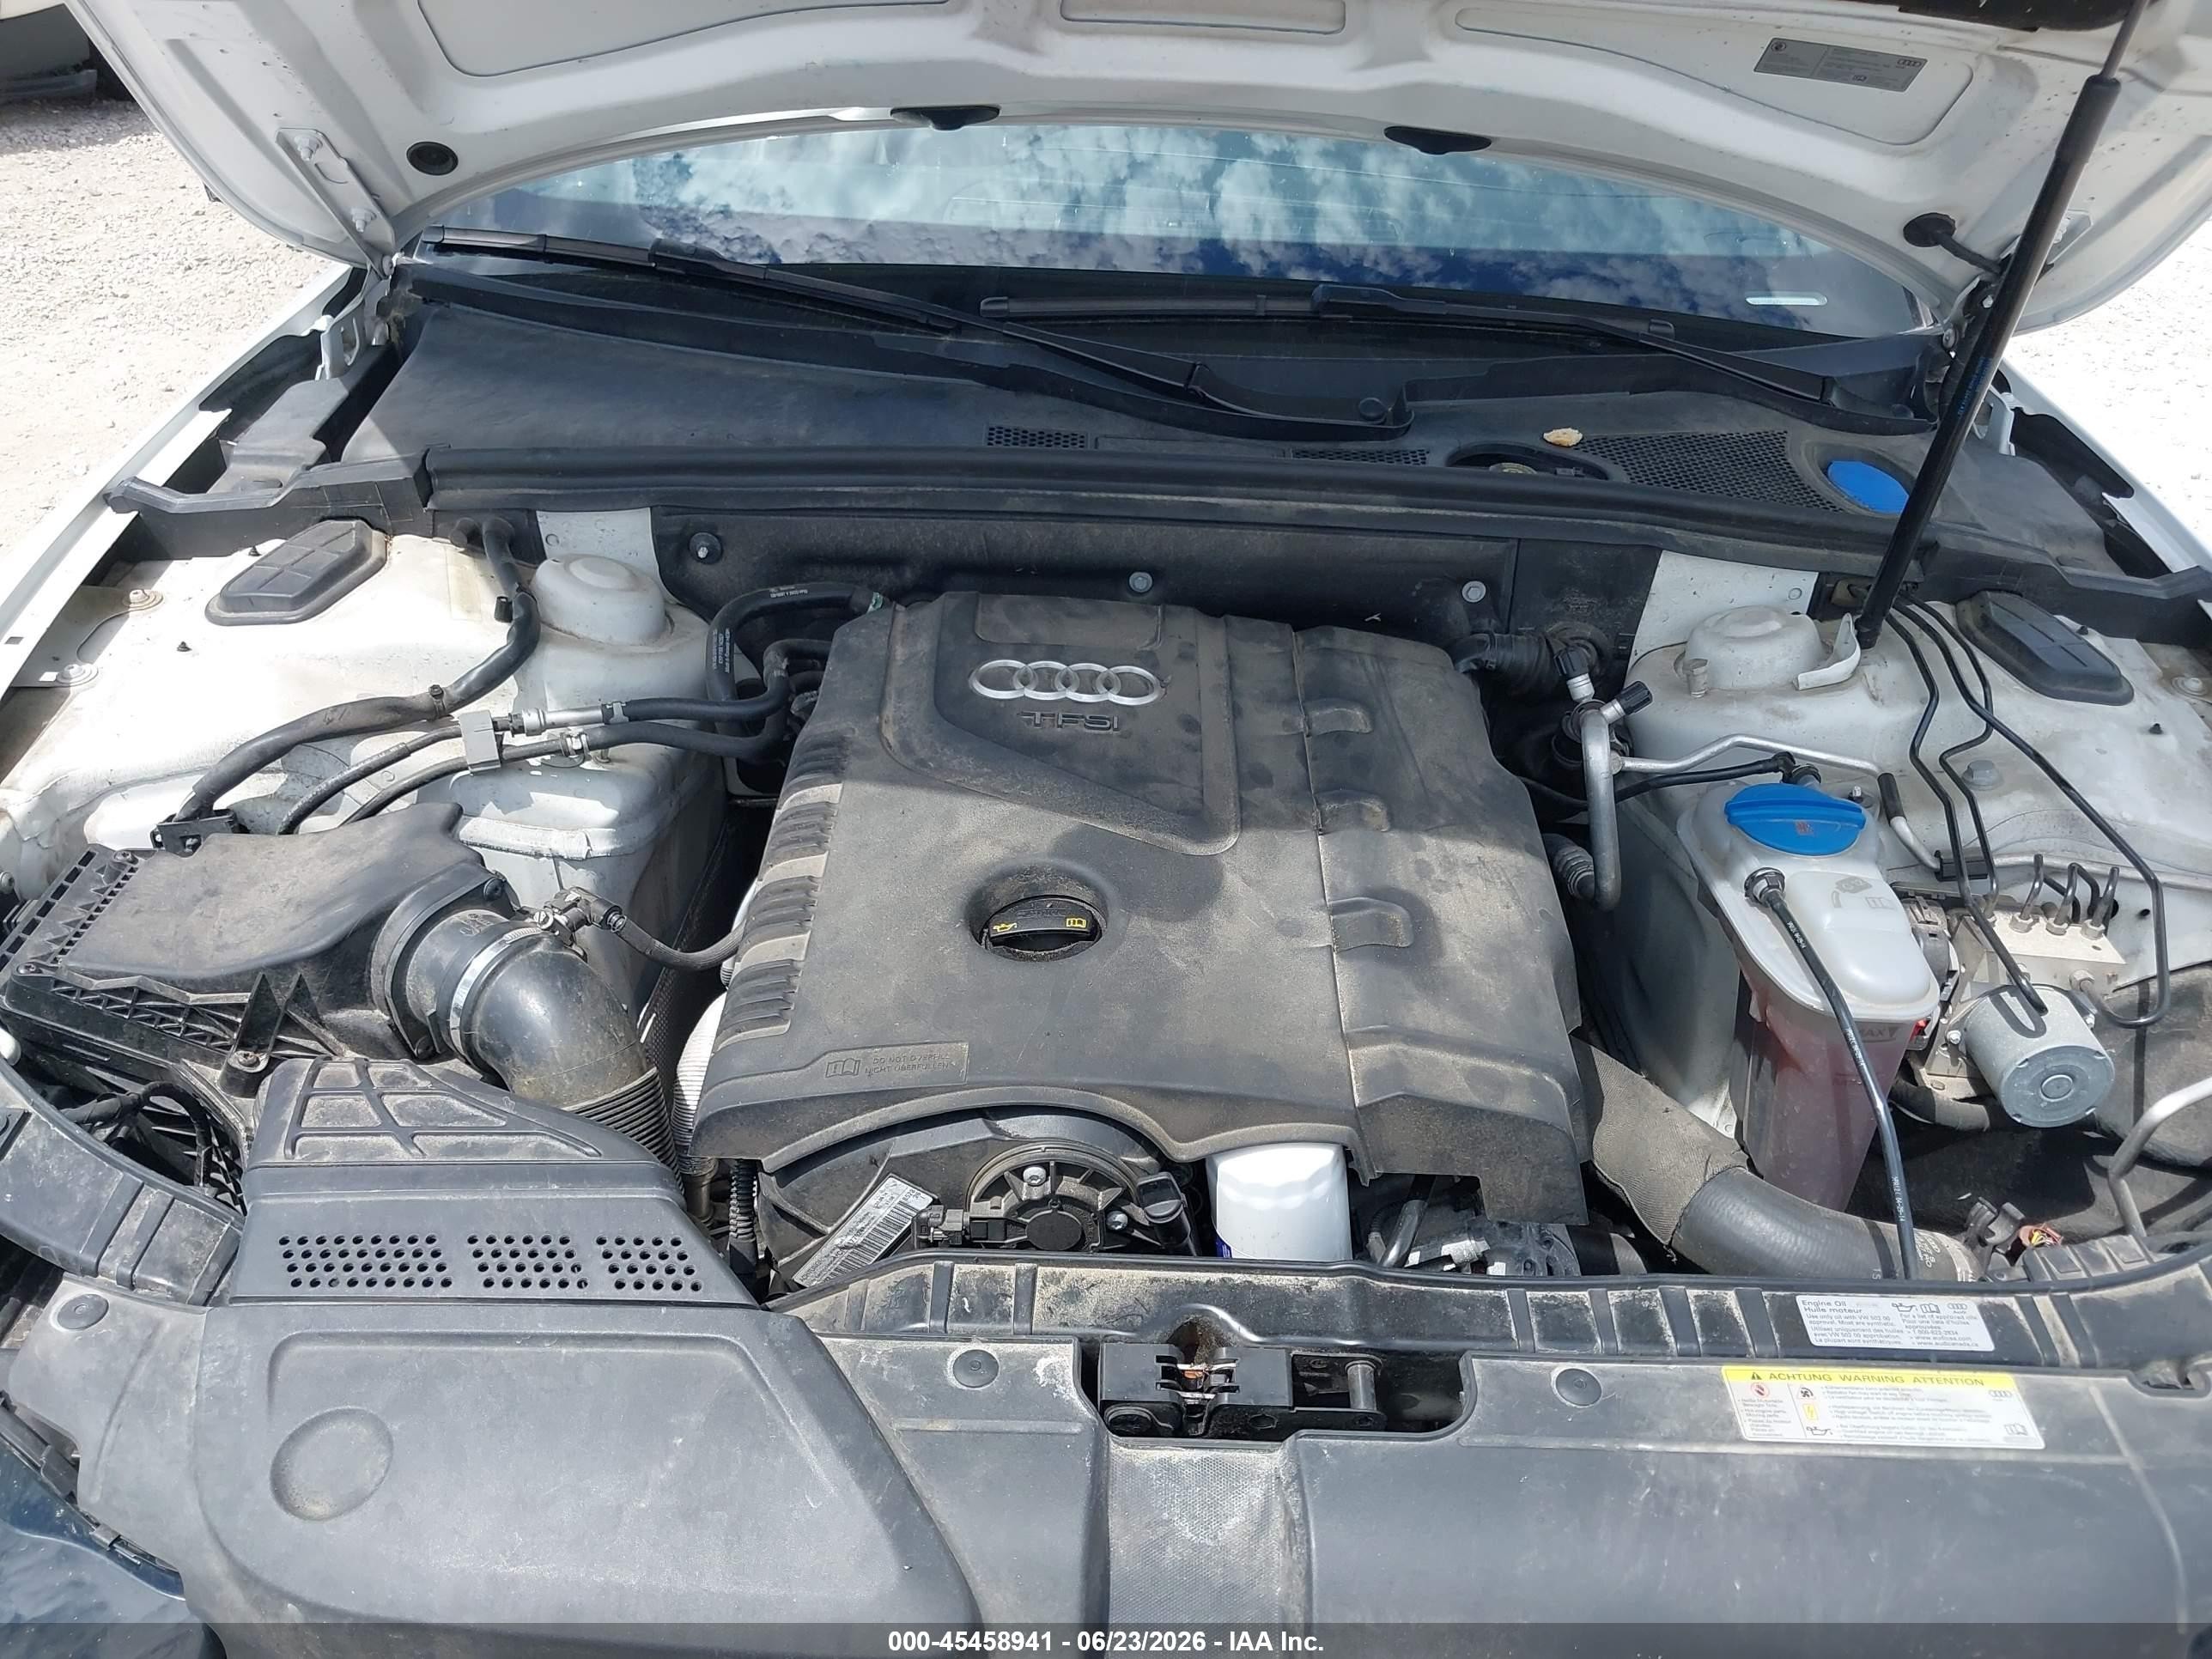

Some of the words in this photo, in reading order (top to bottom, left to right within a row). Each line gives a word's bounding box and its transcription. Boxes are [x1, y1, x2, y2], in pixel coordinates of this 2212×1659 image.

[1019, 711, 1119, 732] TFSI
[865, 1065, 893, 1073] NICHT
[1802, 1299, 1832, 1308] Engine
[1770, 1372, 1832, 1382] ACHTUNG
[1839, 1375, 1905, 1383] WARNING
[1913, 1377, 1984, 1386] ATTENTION
